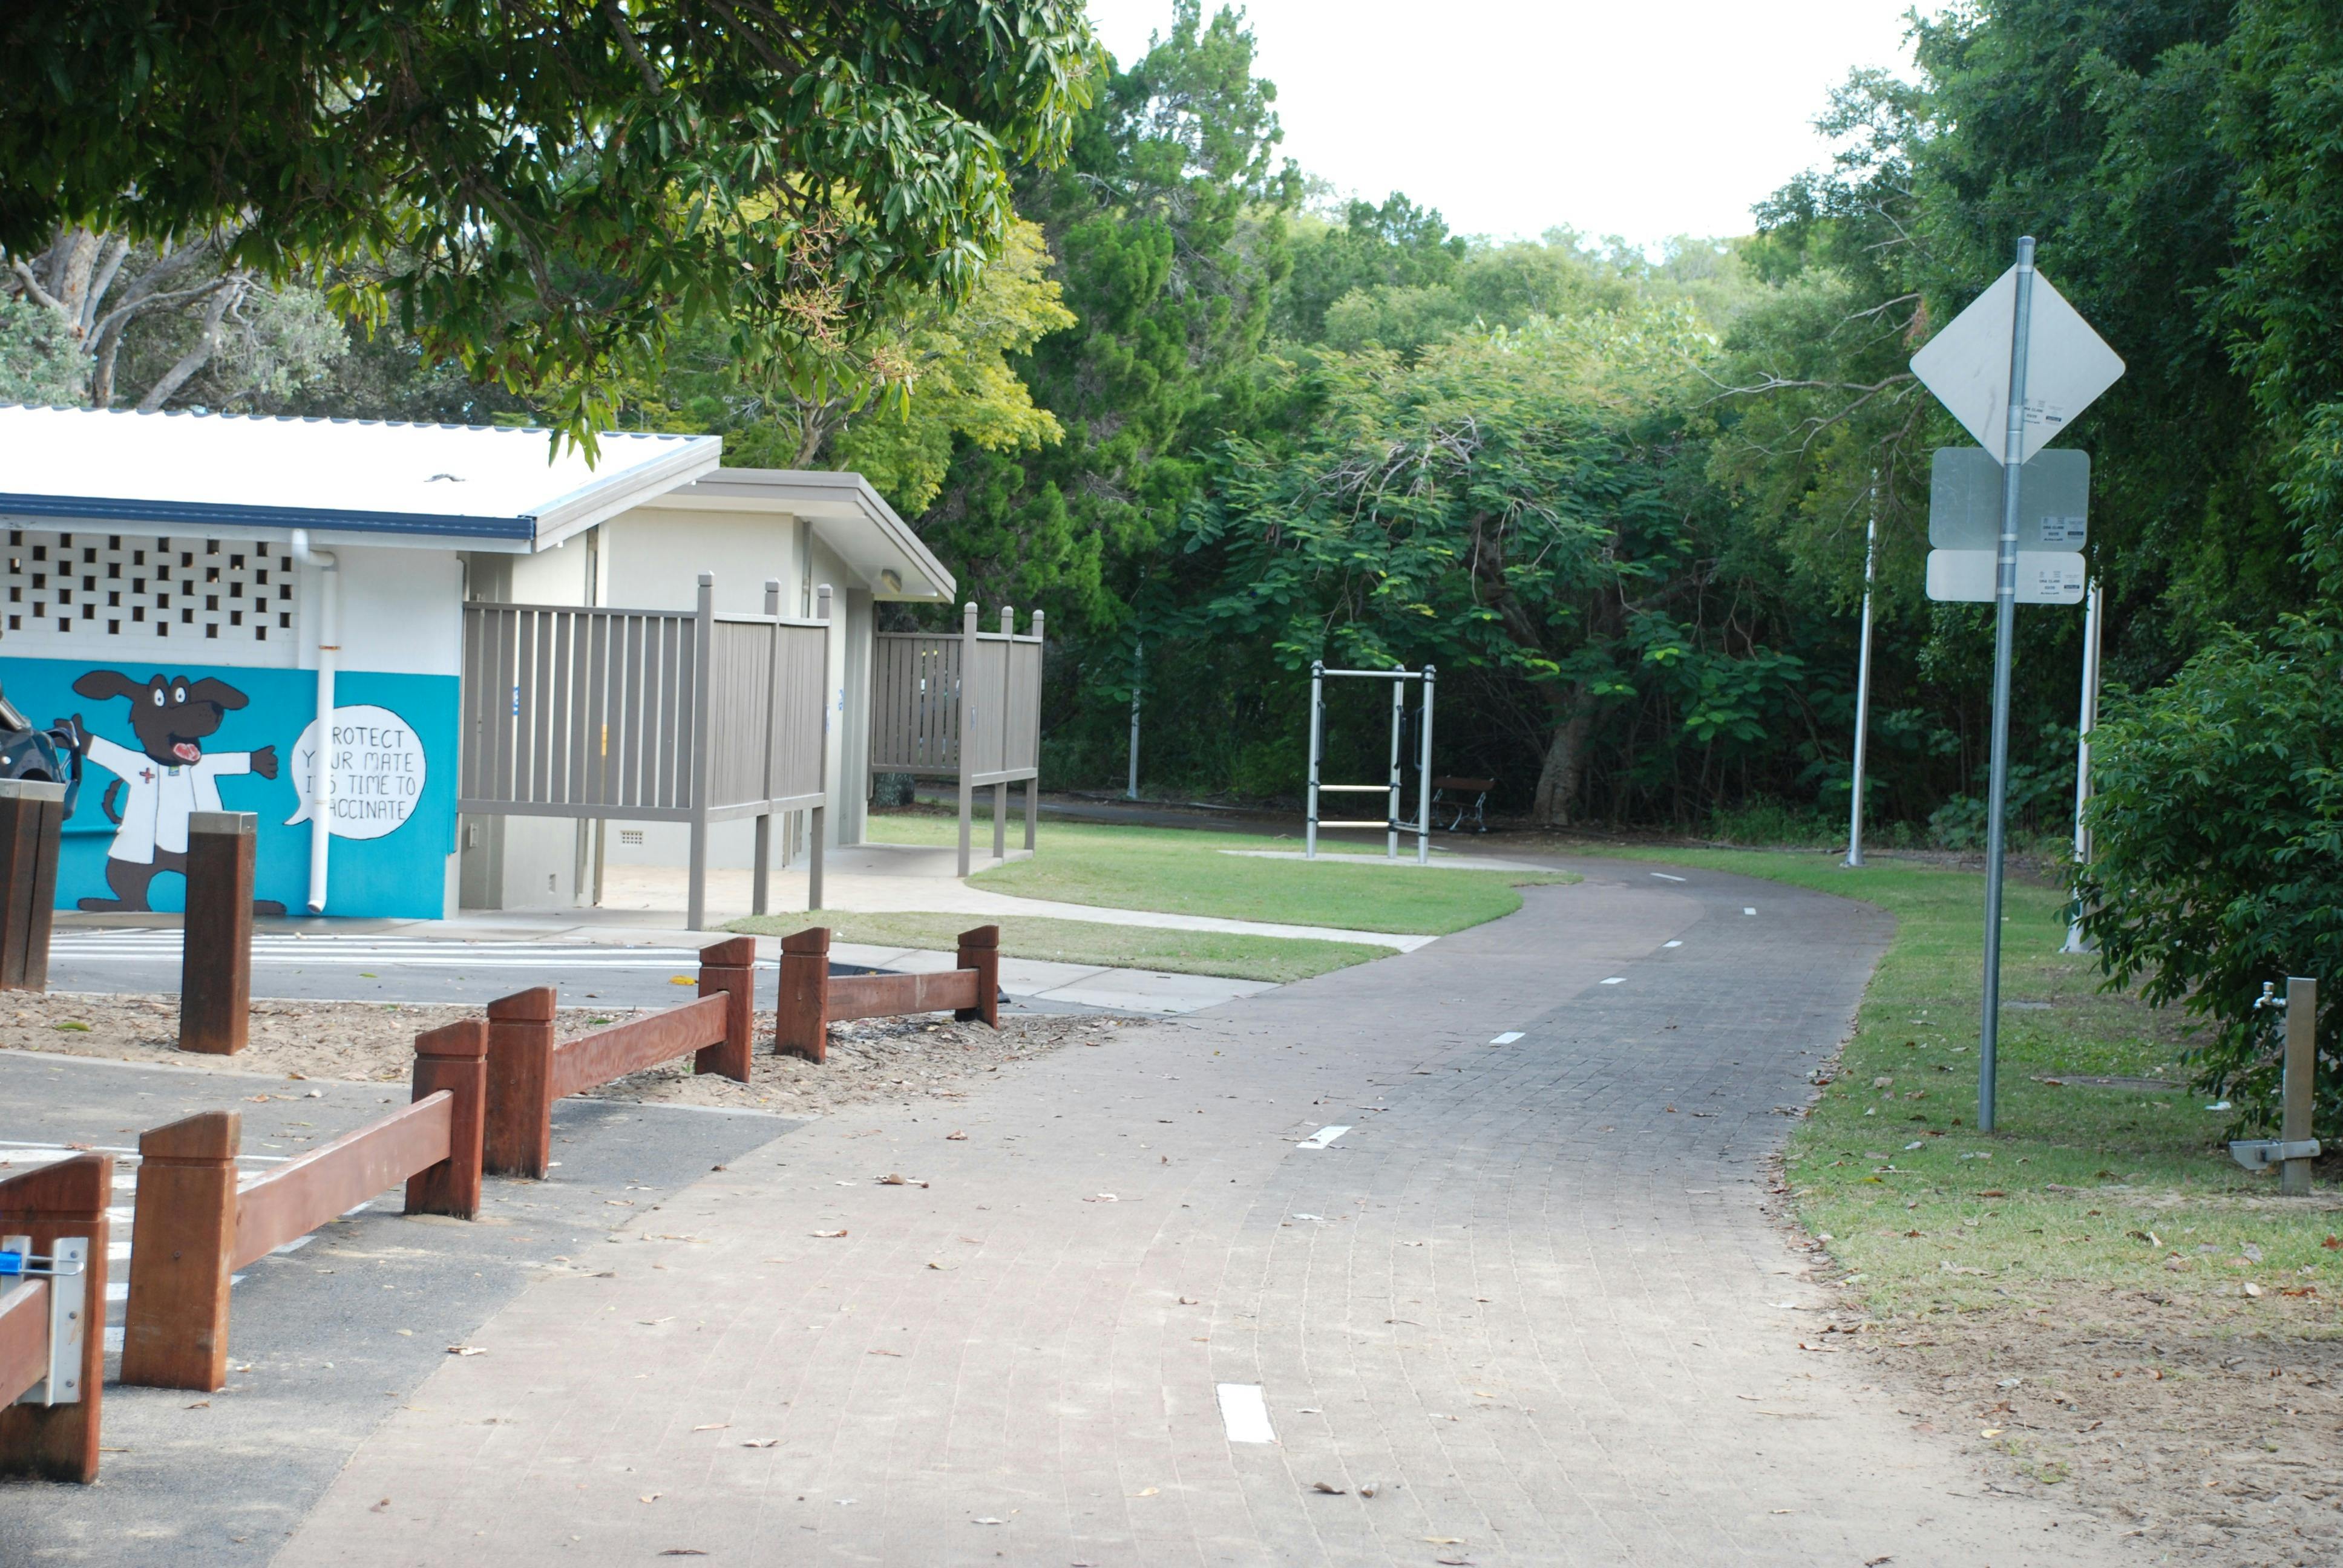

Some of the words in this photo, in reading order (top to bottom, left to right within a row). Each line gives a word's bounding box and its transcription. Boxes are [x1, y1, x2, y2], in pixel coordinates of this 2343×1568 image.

[333, 727, 405, 748] ROTECT
[303, 750, 353, 770] YUR
[364, 752, 414, 773] MATE
[348, 775, 390, 795] TIME
[396, 776, 416, 795] TO
[330, 799, 407, 820] ACCINATE
